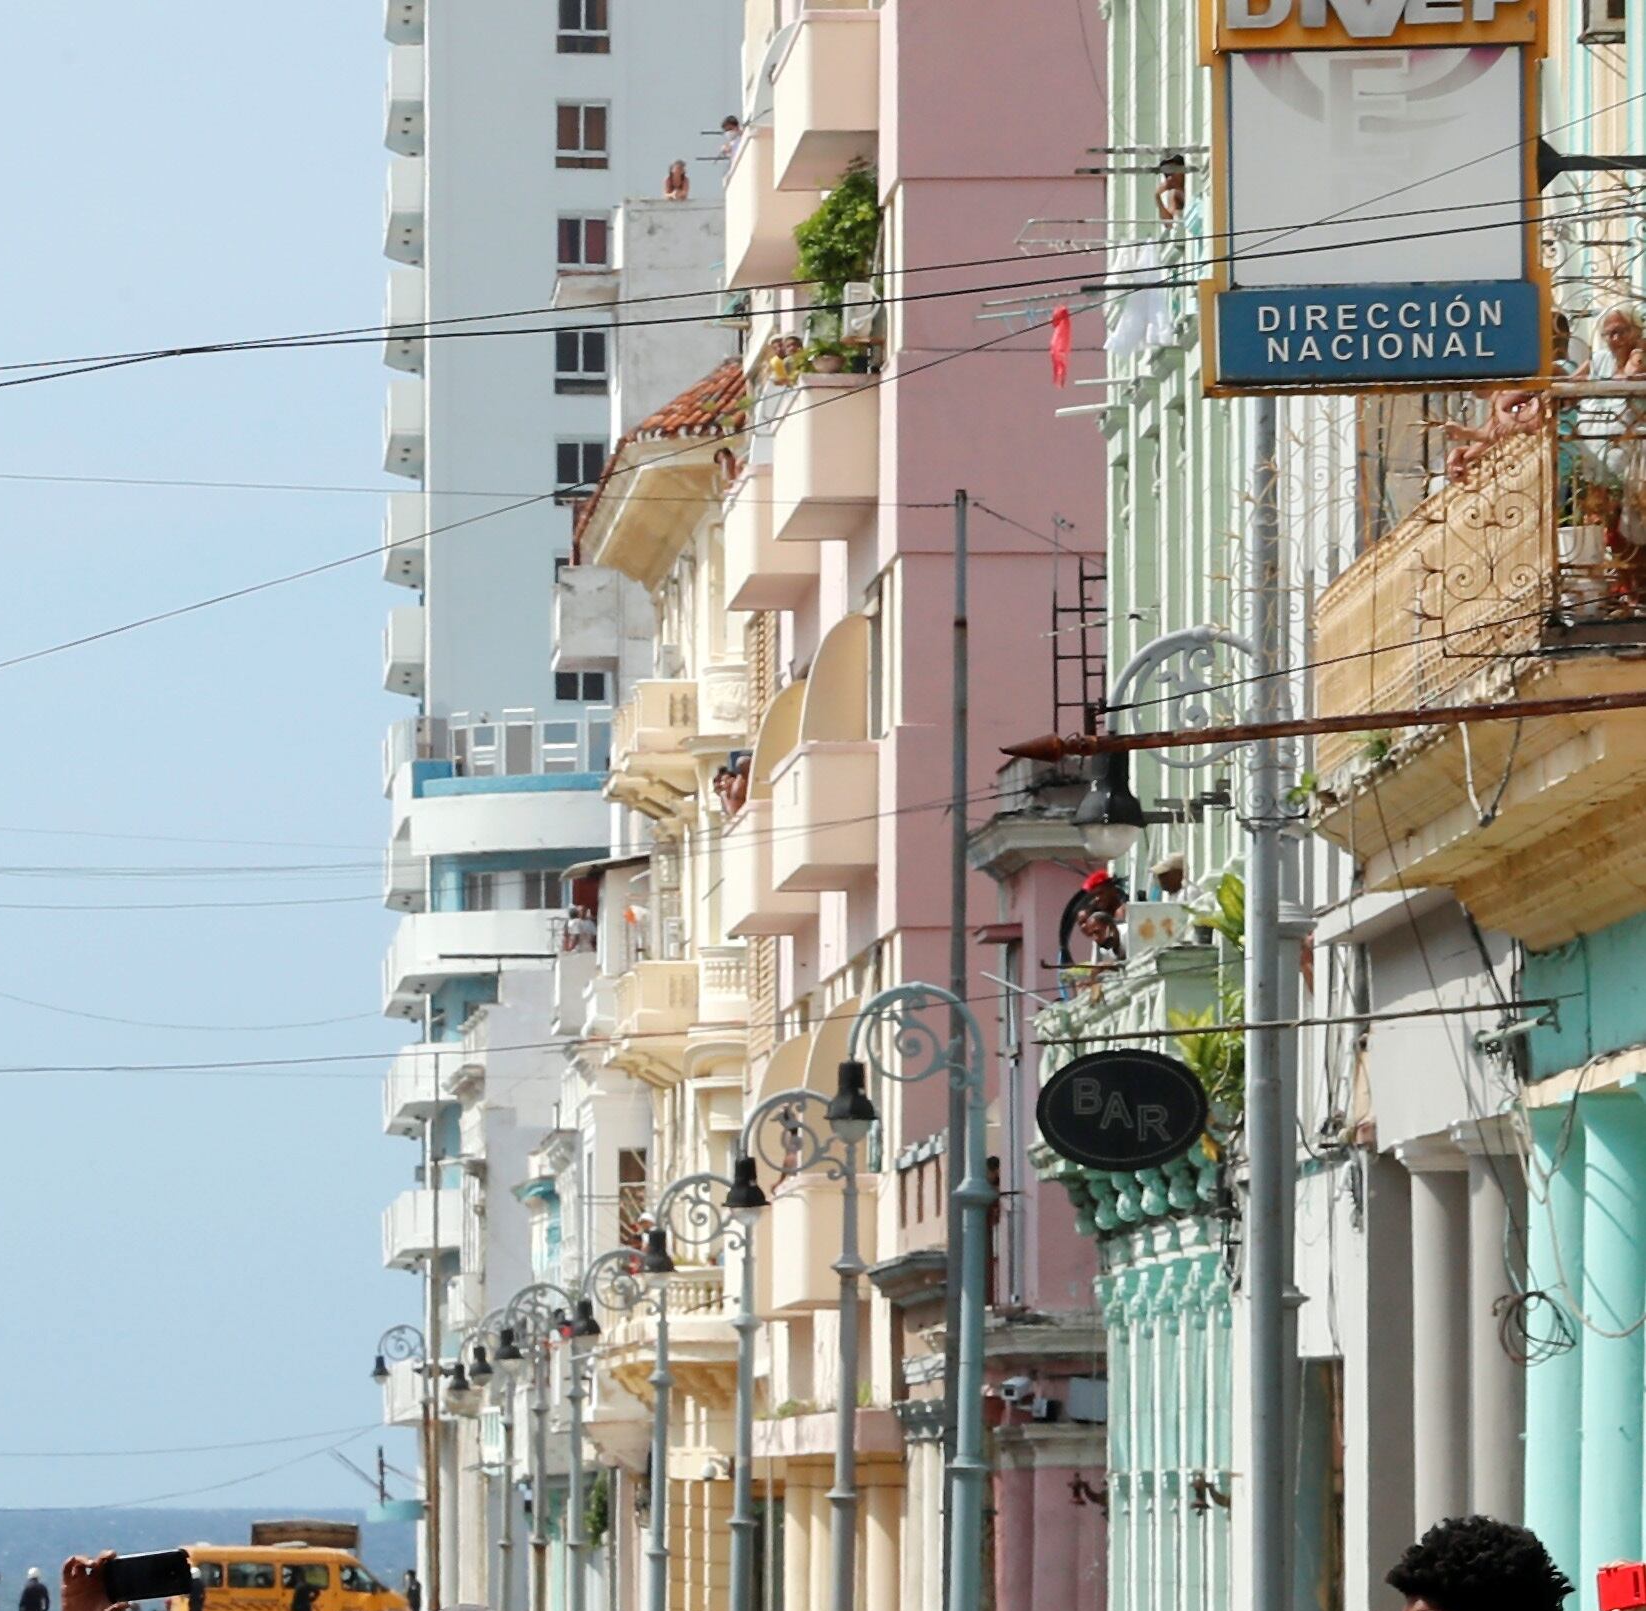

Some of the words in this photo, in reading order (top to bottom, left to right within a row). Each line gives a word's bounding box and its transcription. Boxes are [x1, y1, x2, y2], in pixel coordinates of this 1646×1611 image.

[1257, 293, 1504, 334] DIRECCIÓN
[1266, 331, 1496, 363] NACIONAL
[1071, 1076, 1172, 1143] BAR
